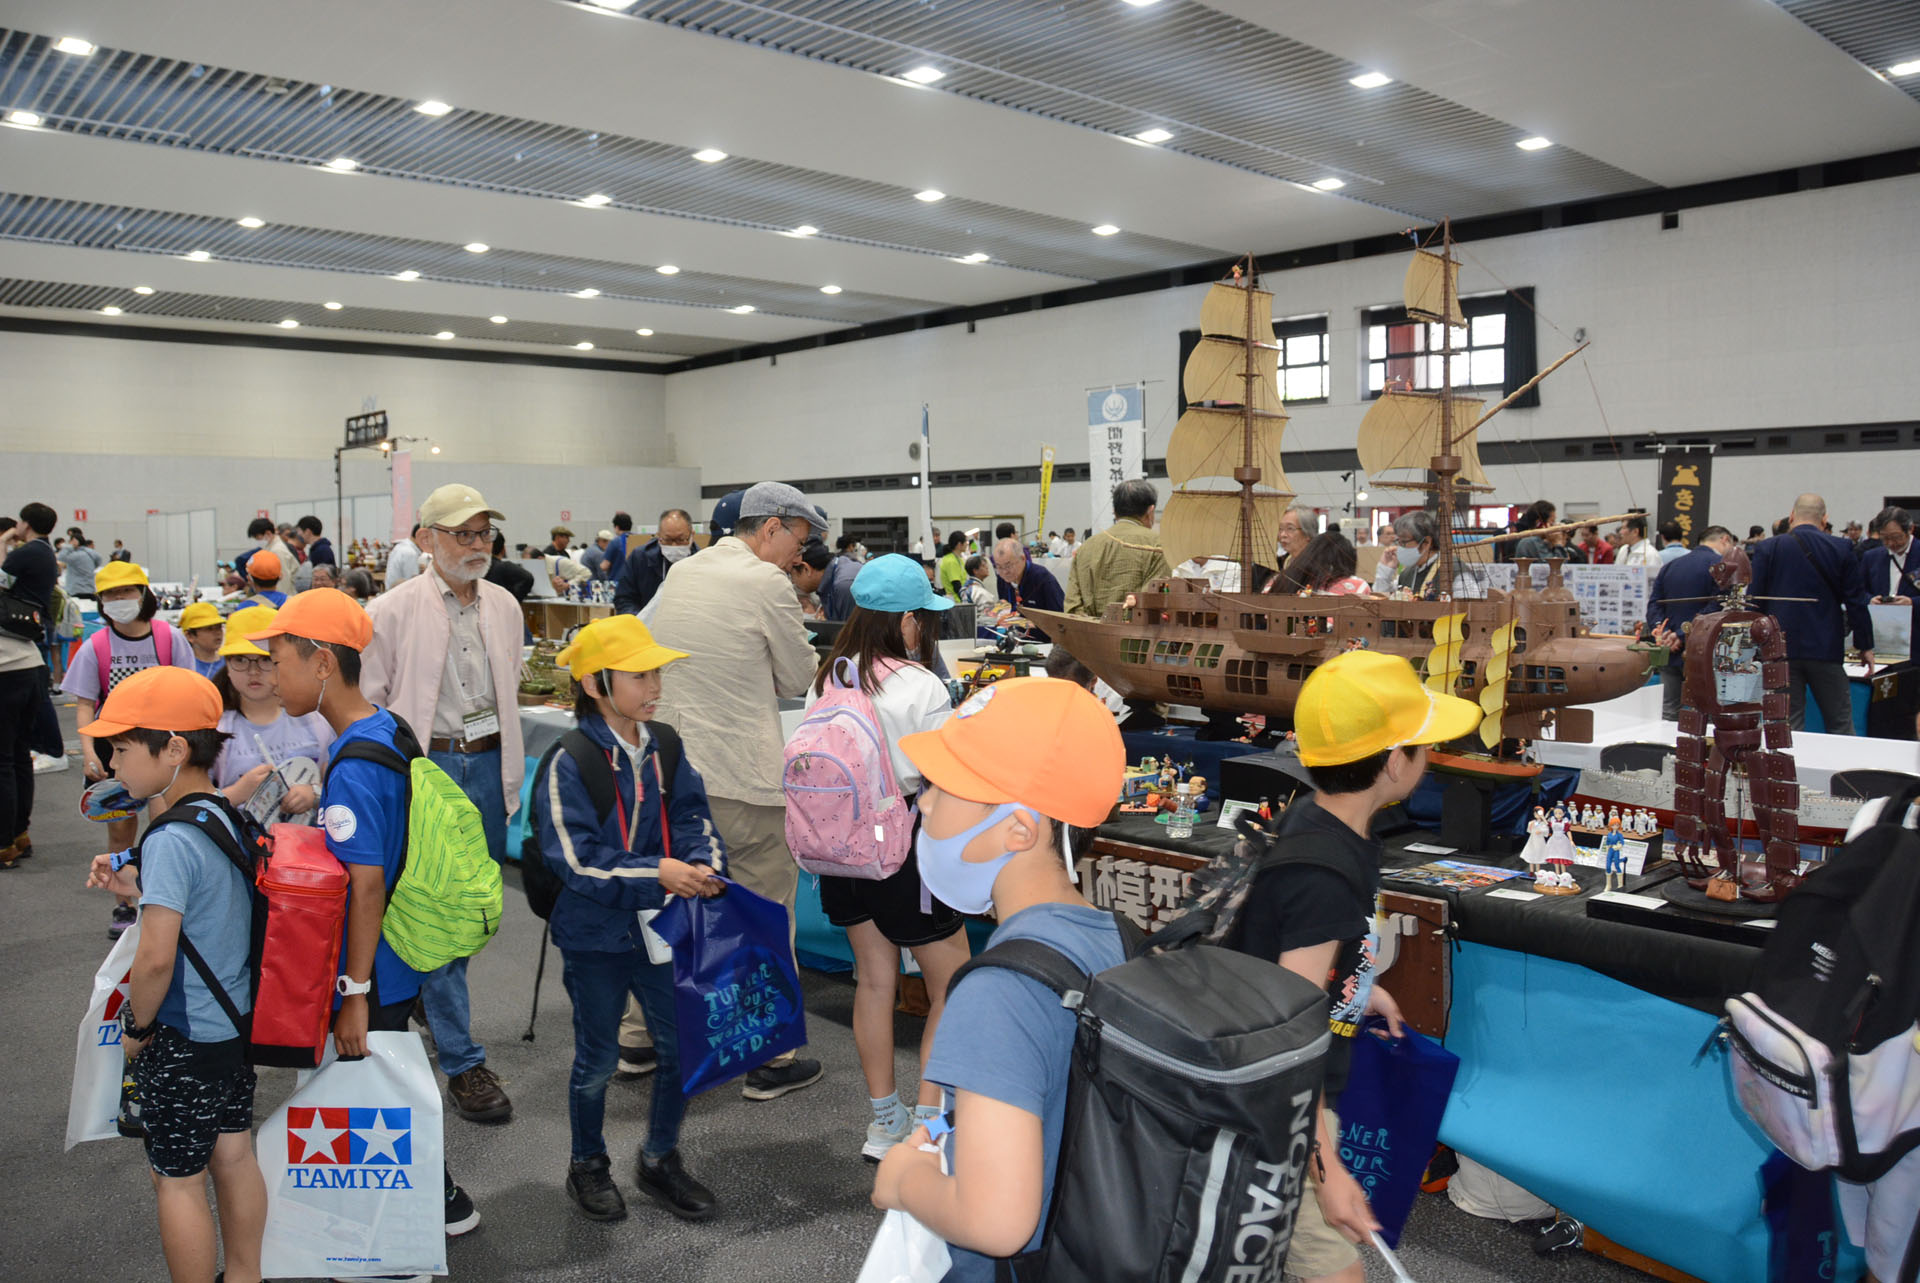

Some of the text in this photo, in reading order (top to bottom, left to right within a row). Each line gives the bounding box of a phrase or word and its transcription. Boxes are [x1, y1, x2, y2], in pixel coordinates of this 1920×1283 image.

[110, 655, 122, 664] RE
[125, 655, 143, 664] TO
[1337, 1122, 1391, 1150] NER
[1340, 1147, 1392, 1176] OUR
[288, 1168, 413, 1189] TAMIYA
